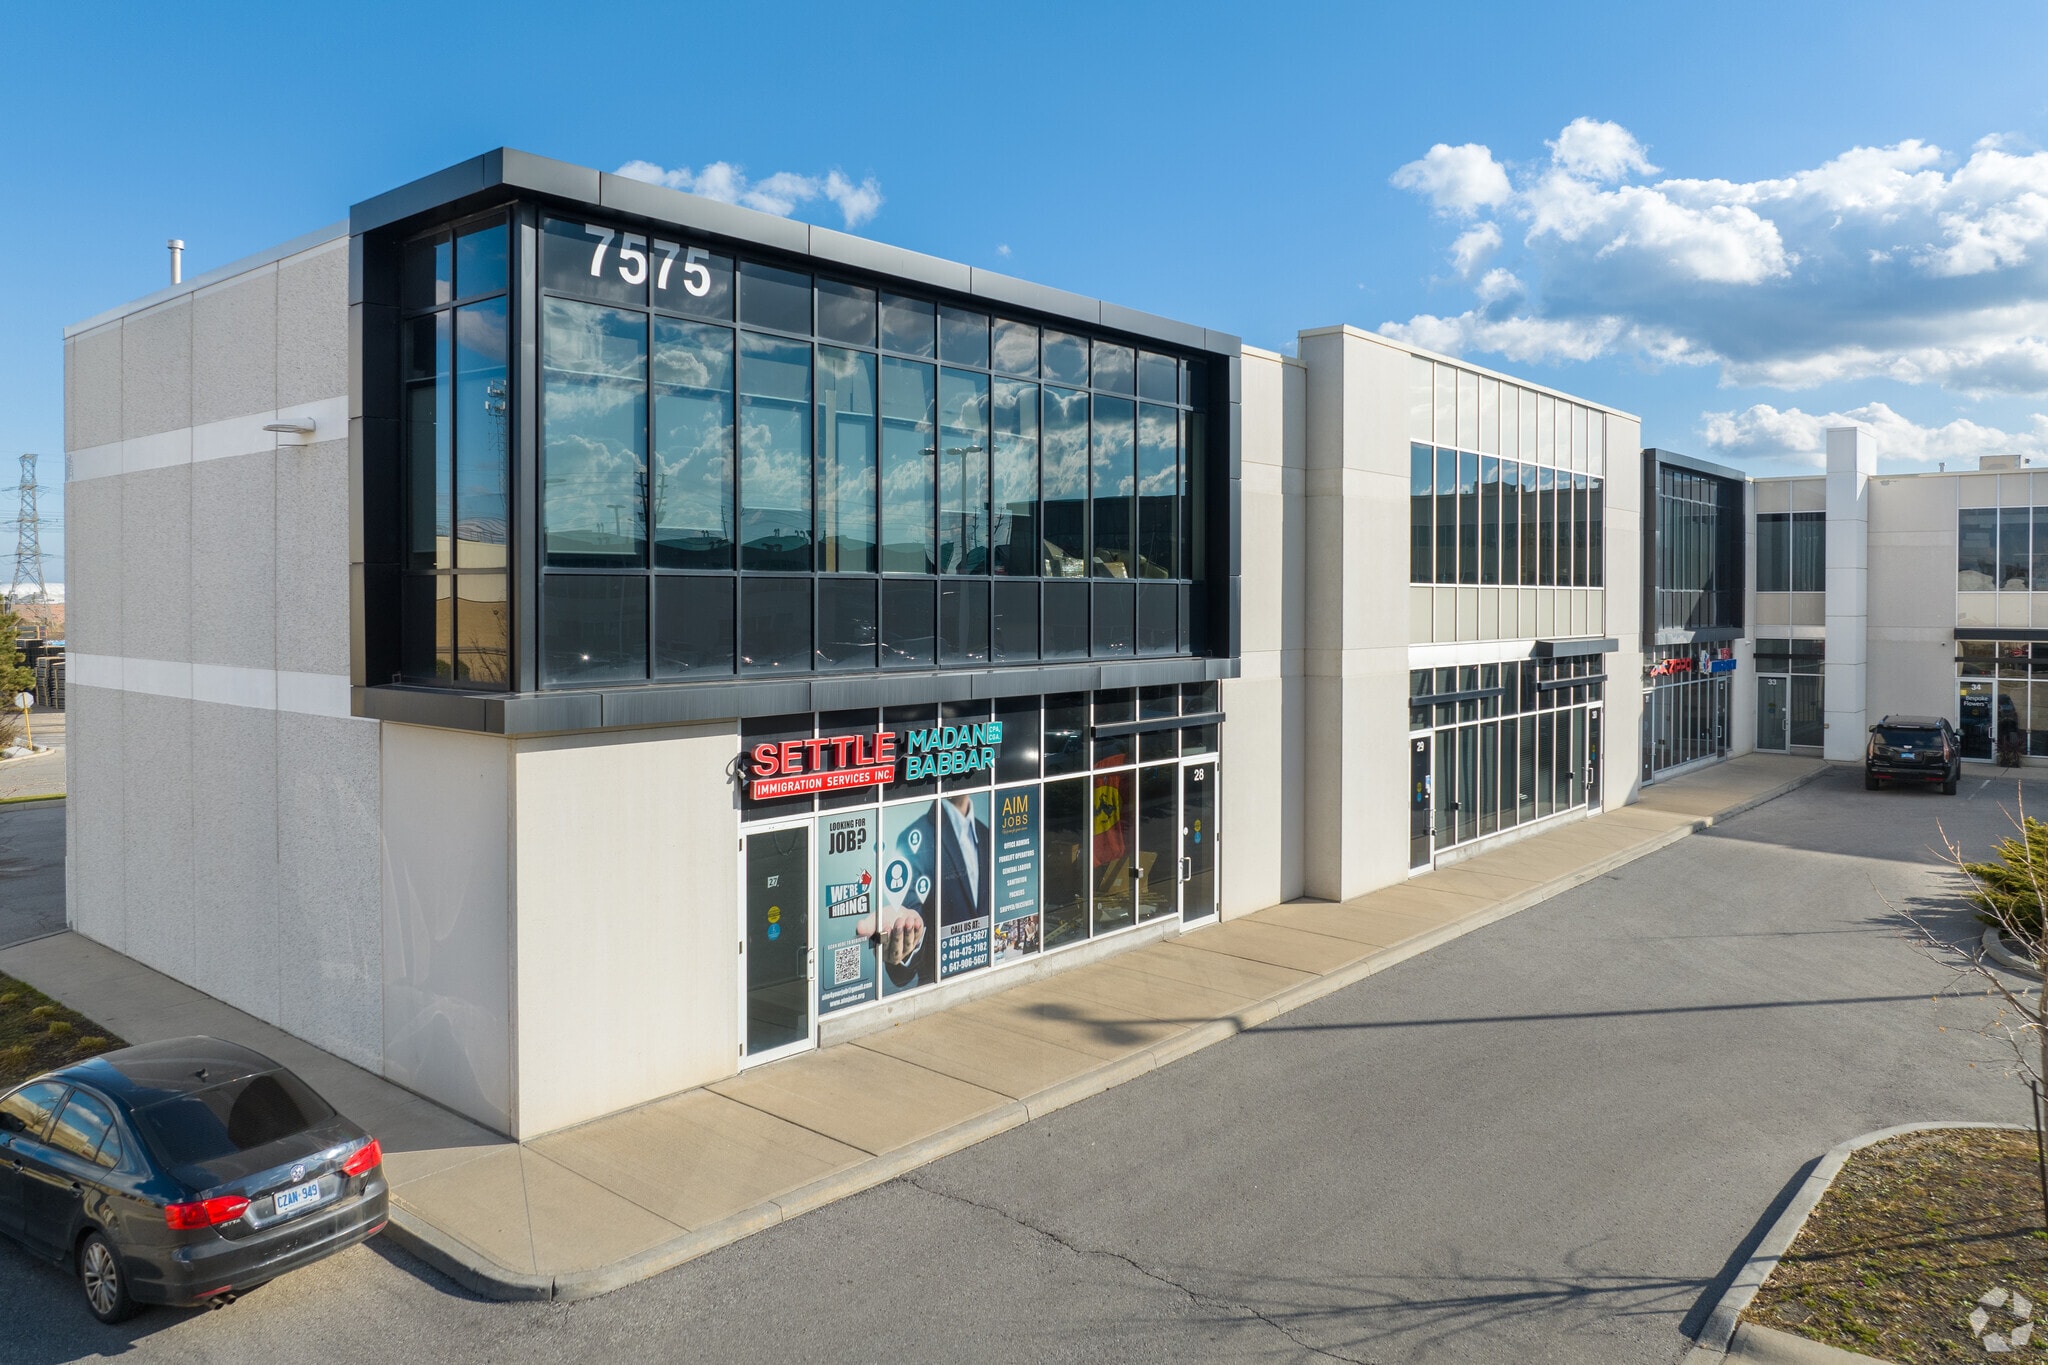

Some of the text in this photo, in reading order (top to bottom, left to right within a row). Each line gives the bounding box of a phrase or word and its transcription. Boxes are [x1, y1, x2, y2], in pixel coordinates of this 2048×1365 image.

[585, 223, 711, 297] 7575
[908, 723, 987, 754] MADAN
[1416, 741, 1425, 752] 29
[752, 732, 896, 776] SETTLE
[905, 747, 996, 780] BABBAR
[757, 769, 892, 796] IMMIGRATION SERVICES INC.
[1193, 768, 1205, 781] 28
[1002, 794, 1028, 816] AIM
[829, 818, 866, 831] LOOKING FOR
[1001, 814, 1028, 829] JOBS
[828, 828, 867, 855] JOB?
[830, 883, 858, 904] WE'RE
[832, 895, 868, 917] HIRING
[949, 930, 987, 948] 416-613-5627
[950, 924, 963, 935] CALL
[964, 921, 971, 931] US
[949, 941, 987, 960] 416-475-7182
[277, 1184, 317, 1208] CZAN 949
